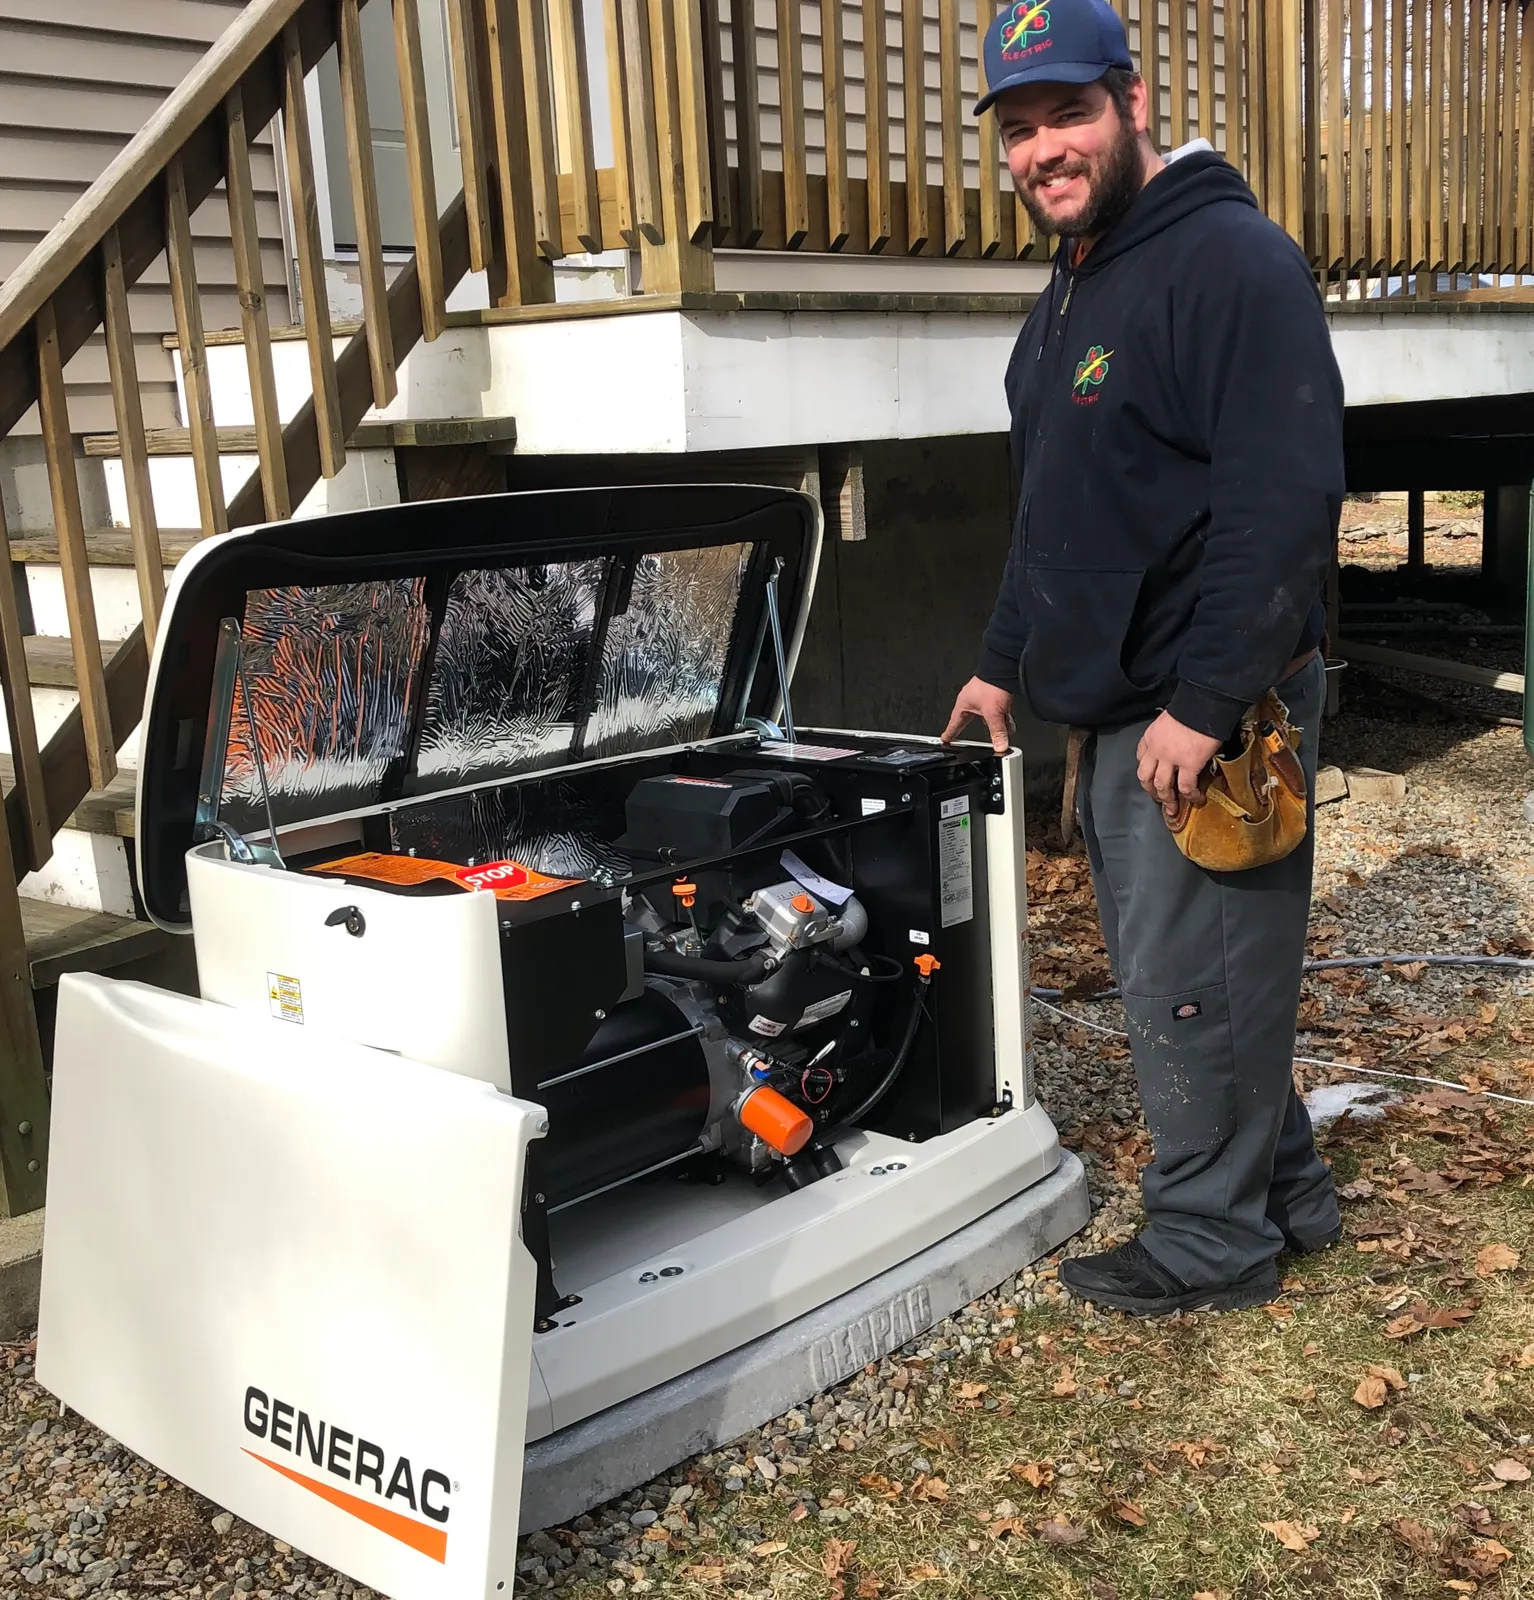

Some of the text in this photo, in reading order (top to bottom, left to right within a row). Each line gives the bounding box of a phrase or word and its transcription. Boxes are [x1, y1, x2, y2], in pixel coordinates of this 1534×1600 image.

[1033, 16, 1045, 29] B
[1002, 38, 1053, 60] ELECTRIC
[465, 865, 514, 886] STOP
[244, 1386, 451, 1524] GENERAC
